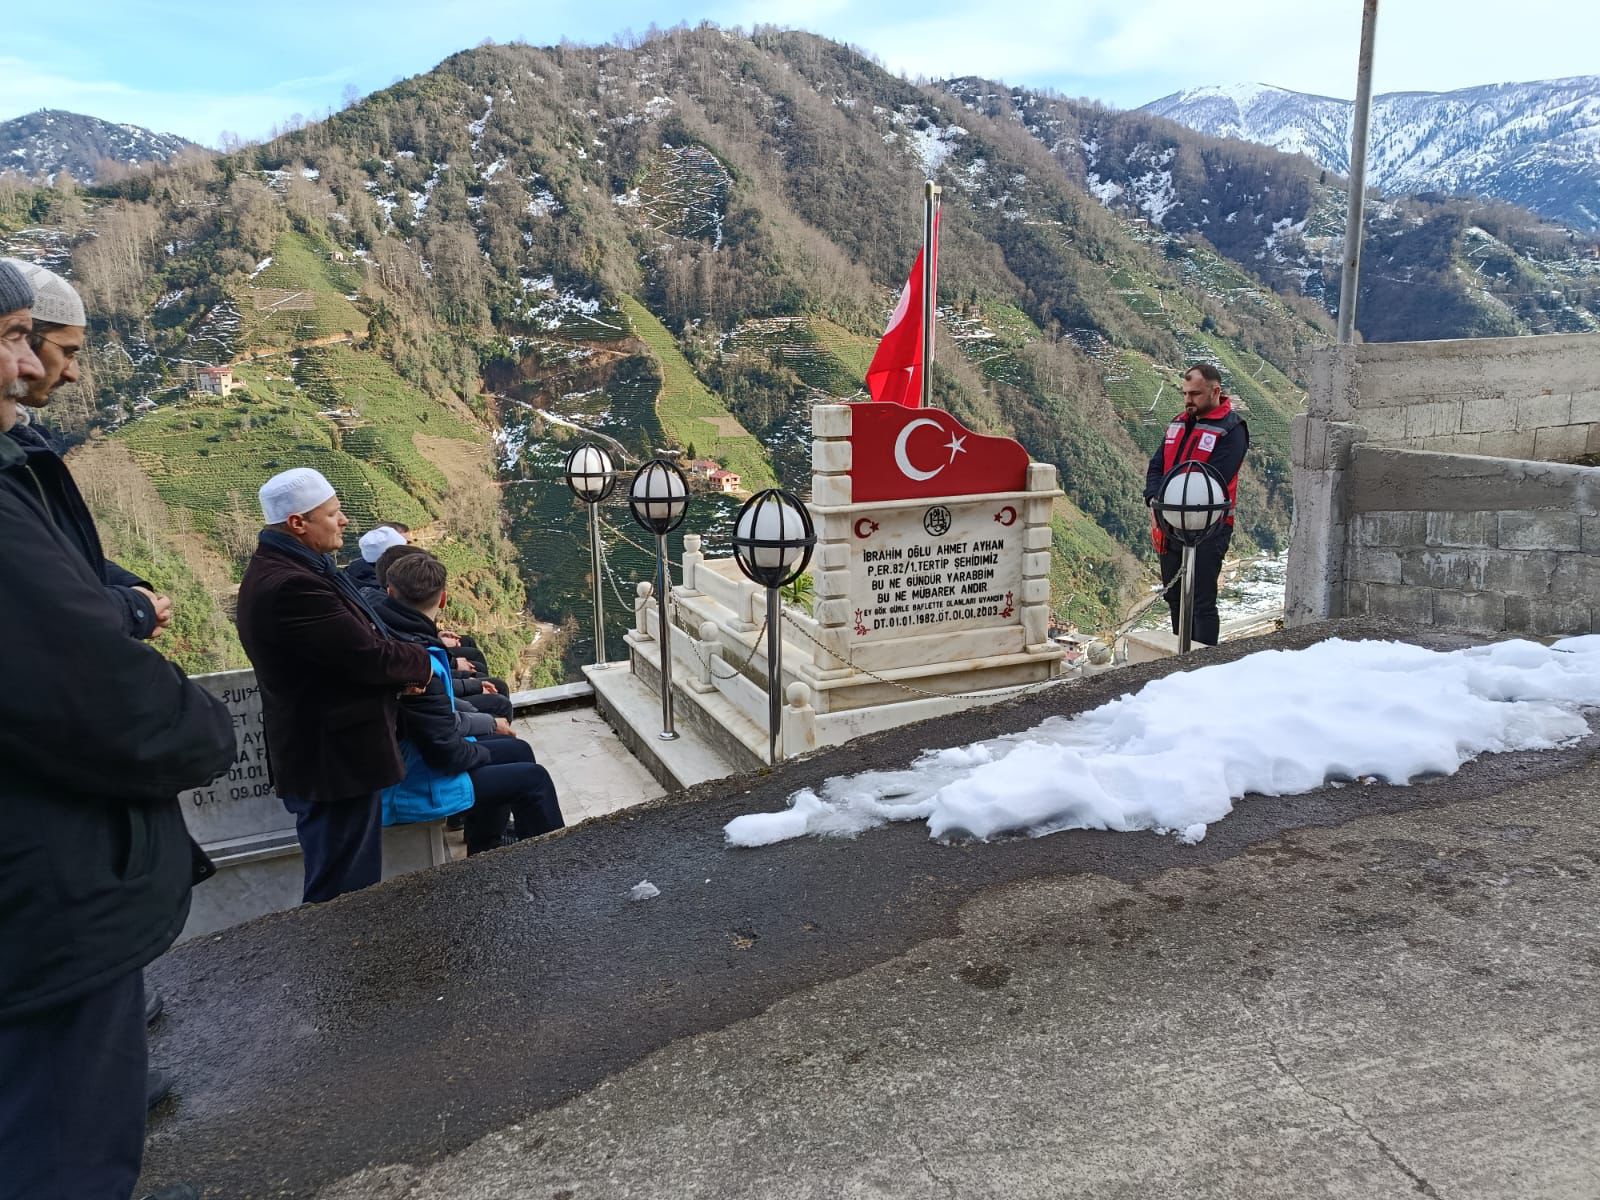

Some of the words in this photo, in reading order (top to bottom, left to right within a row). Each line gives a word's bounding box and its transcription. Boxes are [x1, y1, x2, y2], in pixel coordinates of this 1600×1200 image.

[863, 547, 902, 562] İBRAHİM
[907, 545, 931, 558] OĞLU
[937, 543, 967, 555] AHMET
[973, 539, 1004, 552] AYHAN
[872, 580, 884, 590] BU
[890, 578, 901, 589] NE
[907, 573, 942, 587] GÜNDÜR
[947, 568, 994, 583] YARABBİM
[877, 593, 890, 603] BU
[895, 591, 907, 601] NE
[912, 586, 955, 600] MÜBAREK
[961, 582, 988, 594] ANDIR
[864, 609, 872, 617] EY
[231, 713, 247, 728] ET
[243, 731, 262, 744] AY
[228, 765, 267, 781] 01.01.
[230, 783, 275, 801] 09.09.
